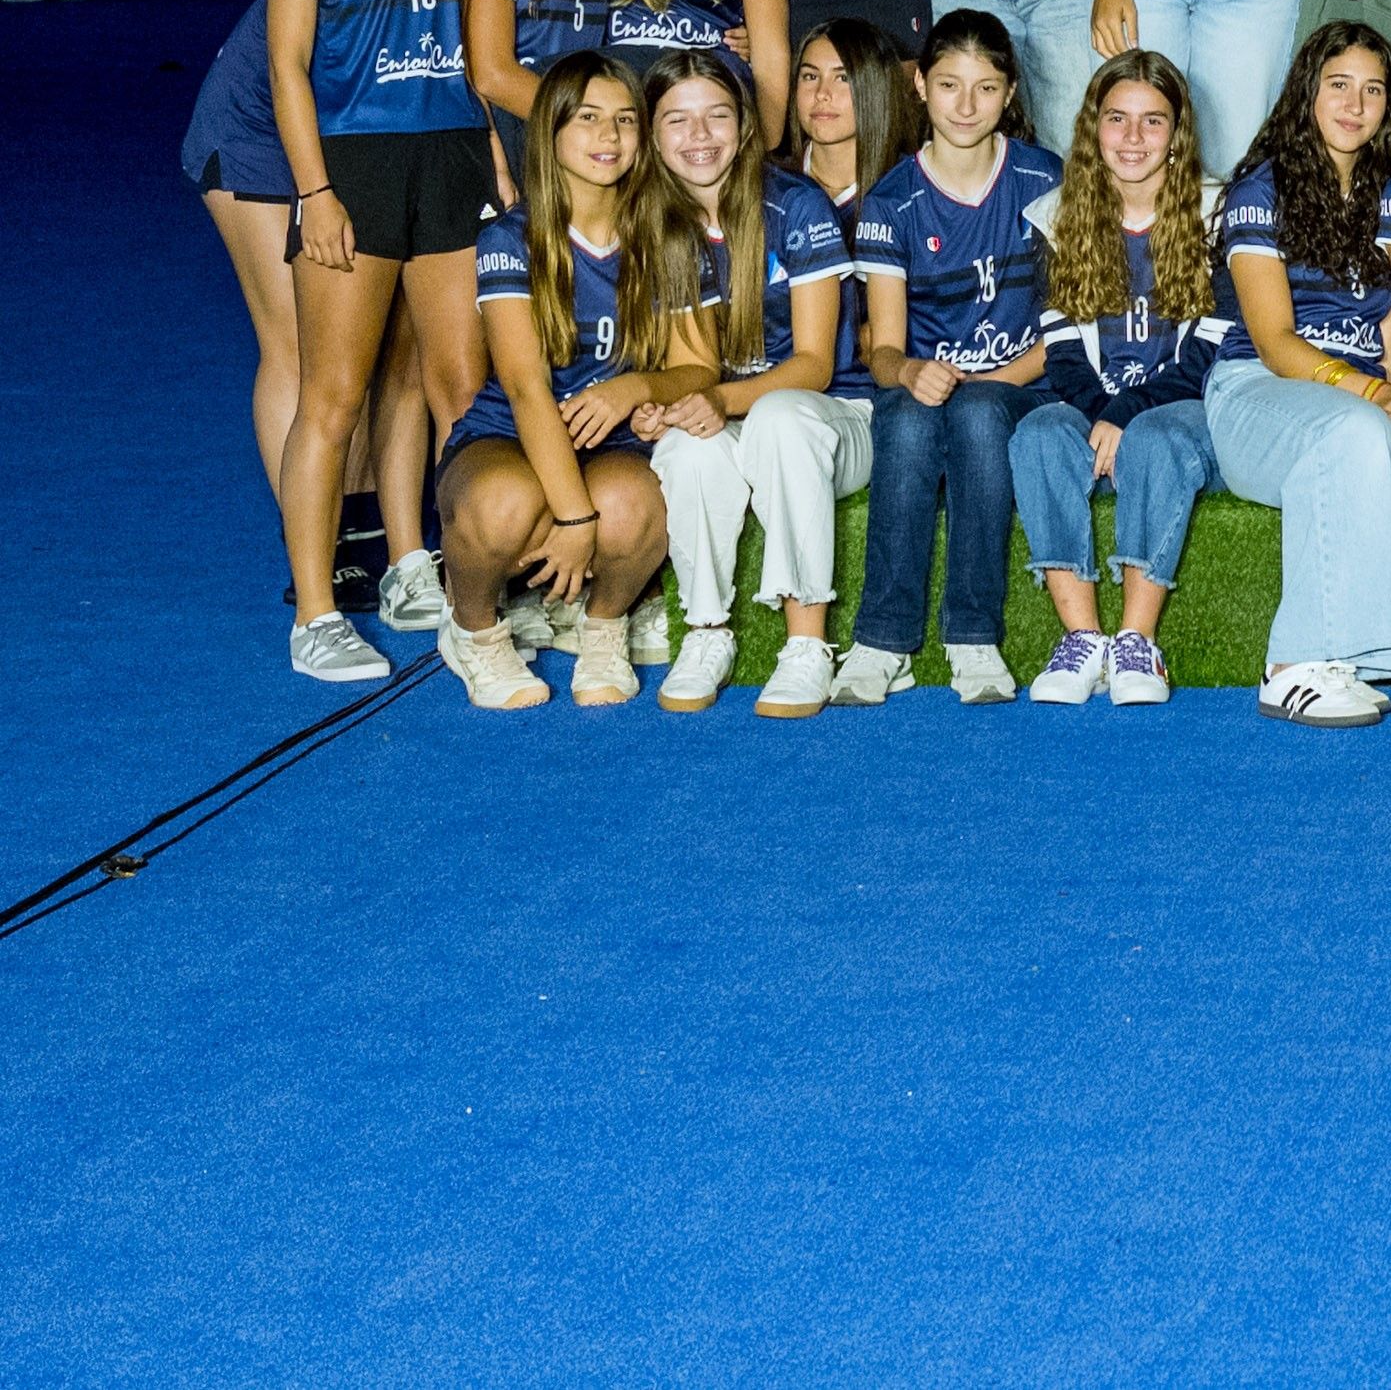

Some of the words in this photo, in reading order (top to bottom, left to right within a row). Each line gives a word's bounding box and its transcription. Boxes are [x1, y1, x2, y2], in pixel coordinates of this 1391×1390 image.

[610, 11, 673, 48] Enjoy
[375, 47, 432, 77] Enjoy
[432, 45, 465, 72] Cub
[856, 221, 894, 244] OOBAL
[1227, 205, 1278, 228] GLOOBA
[1125, 296, 1150, 343] 13
[1296, 321, 1358, 350] njoy
[595, 315, 615, 361] 9
